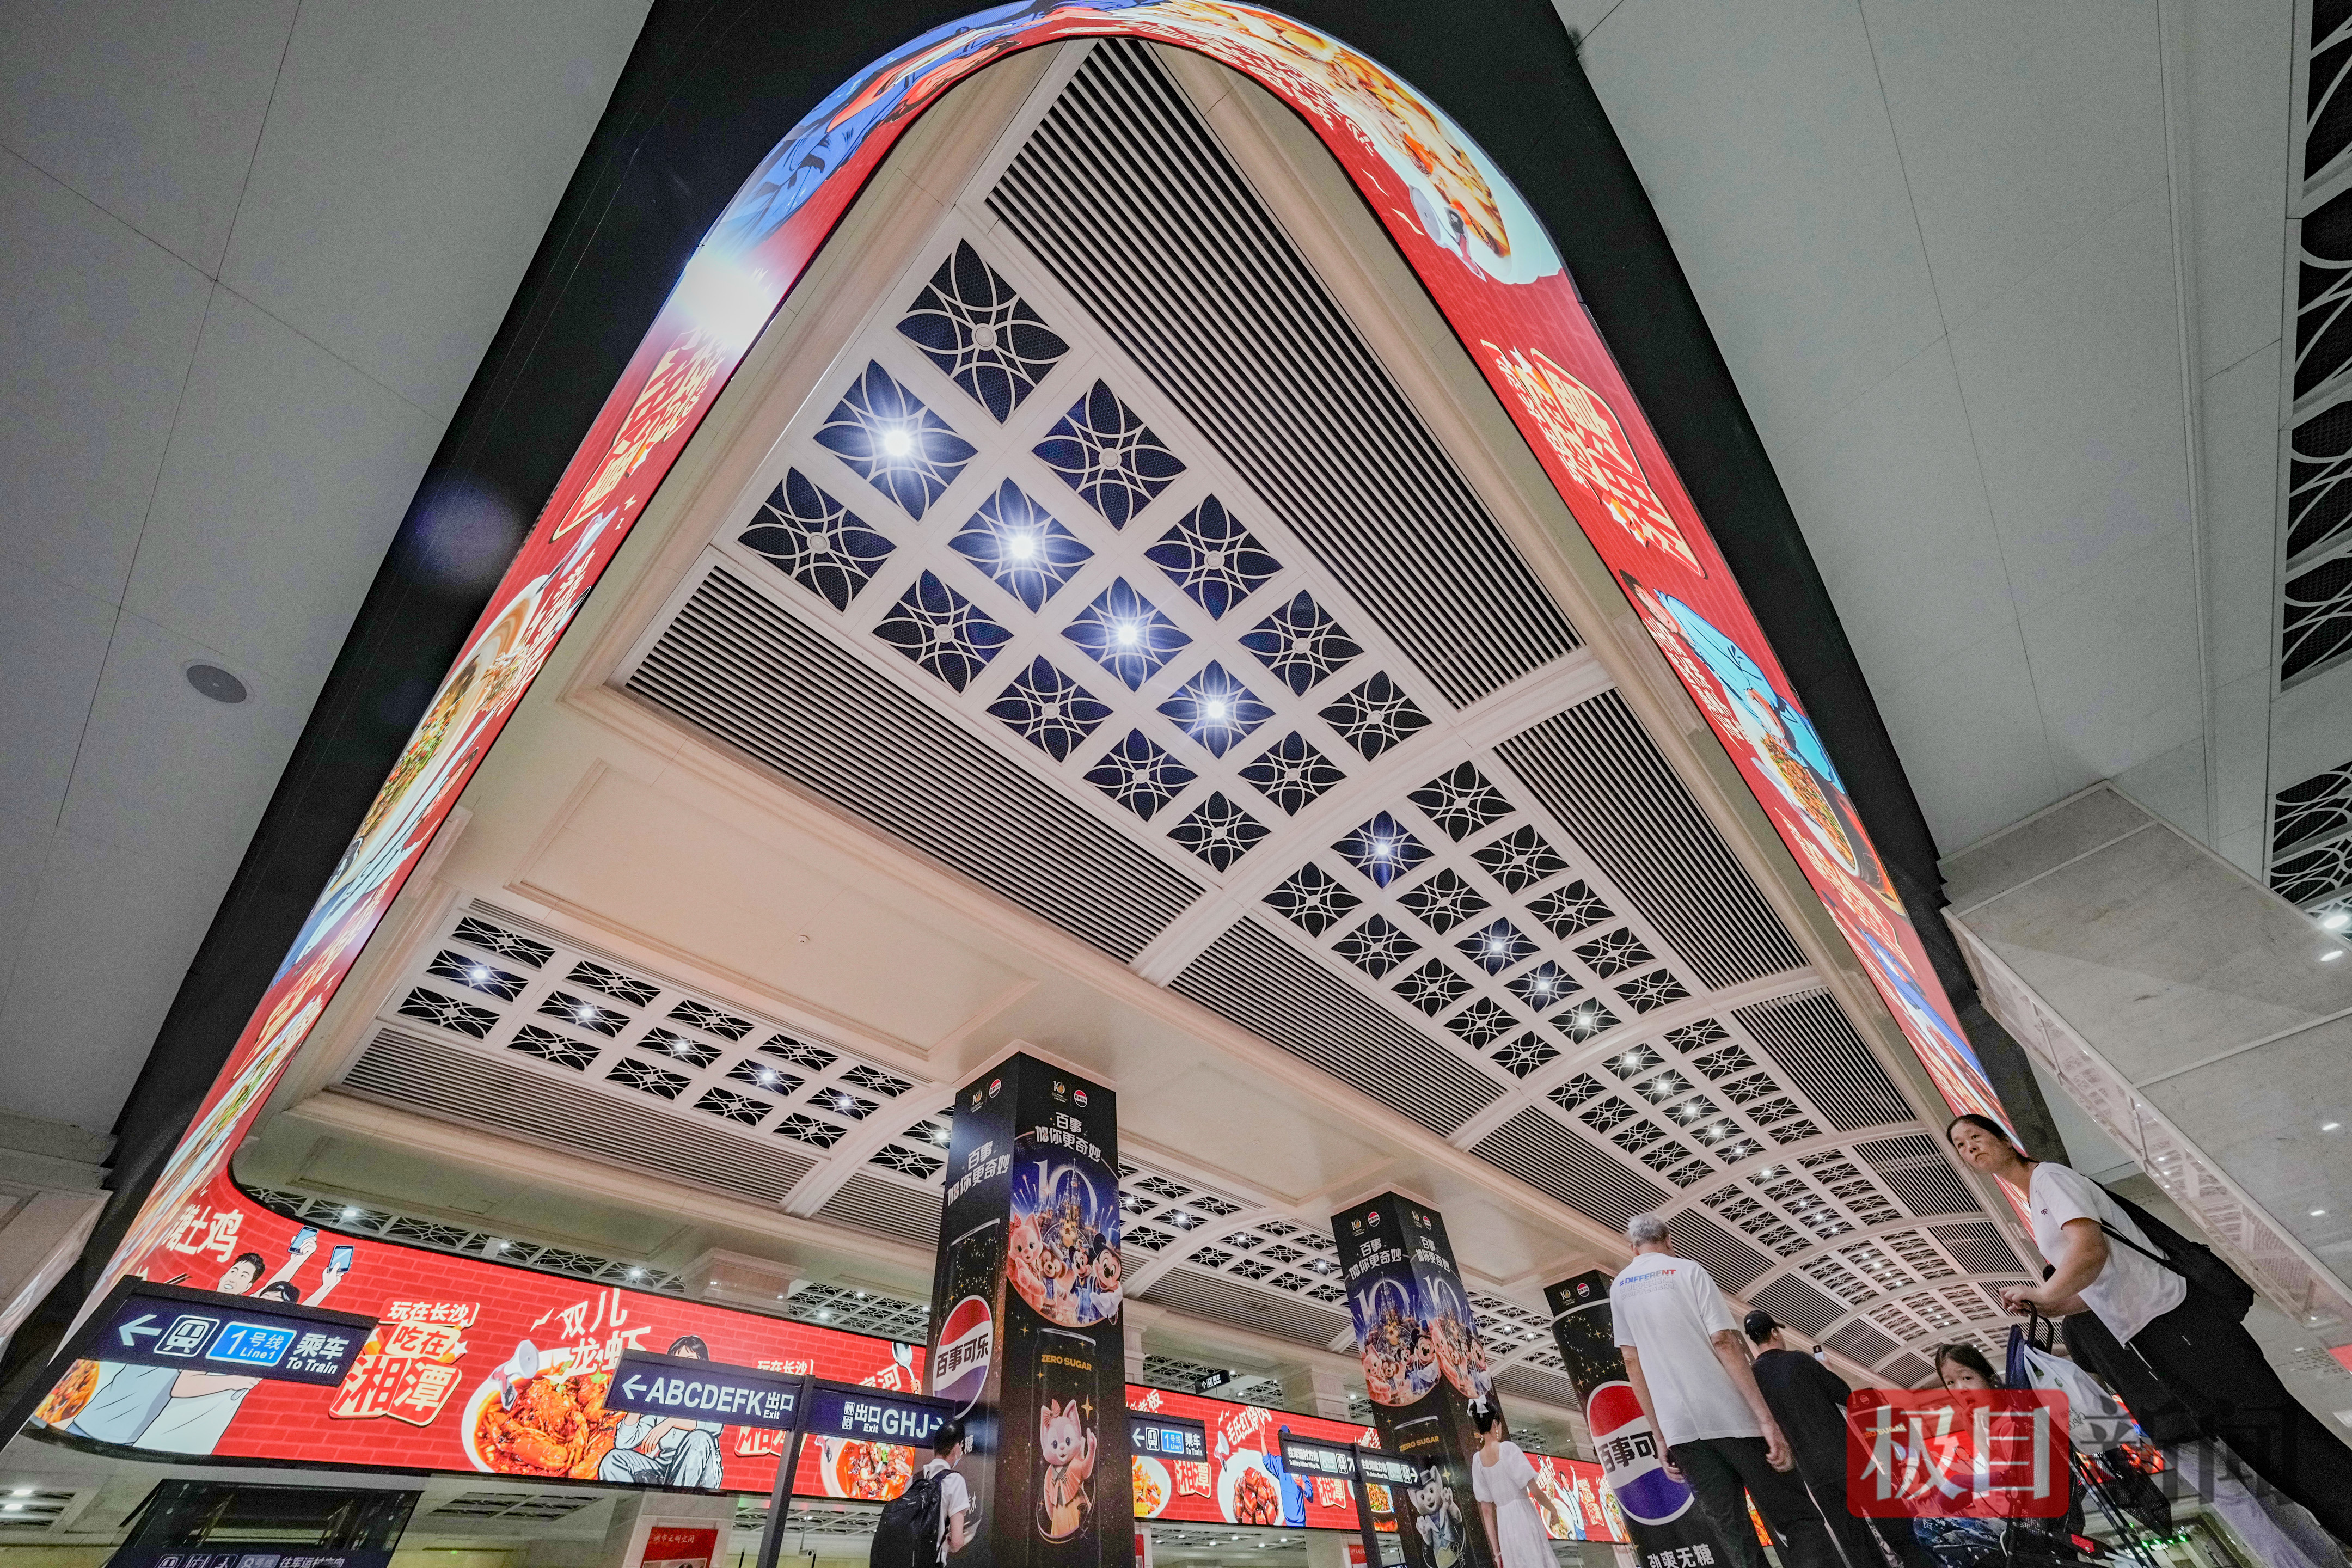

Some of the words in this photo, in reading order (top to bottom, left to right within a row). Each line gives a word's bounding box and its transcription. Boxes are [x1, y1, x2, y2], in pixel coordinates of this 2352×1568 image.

[1492, 357, 1589, 488] 玩在长沙
[1527, 383, 1598, 480] 吃在
[1535, 361, 1701, 575] 湘潭
[1056, 1111, 1082, 1133] 百事
[968, 1141, 994, 1171] 百事
[1034, 1125, 1102, 1163] 加你更奇妙
[947, 1153, 1010, 1206] 加你更奇妙
[1360, 1238, 1382, 1257] 百事
[1420, 1236, 1436, 1252] 百事
[1348, 1248, 1402, 1281] 加你更奇妙
[1619, 1269, 1676, 1287] #DIFFERENT
[387, 1300, 469, 1322] 玩在长沙
[227, 1329, 285, 1355] 1号线
[293, 1332, 350, 1361] 乘车
[393, 1326, 451, 1357] 吃在
[286, 1356, 303, 1370] To
[304, 1359, 338, 1375] Train
[757, 1359, 808, 1376] 玩在长沙
[936, 1332, 989, 1379] 百事可乐
[1040, 1354, 1063, 1367] ZERO
[1064, 1357, 1092, 1372] SUGAR
[334, 1355, 457, 1413] 湘潭
[645, 1377, 766, 1417] ABCDEFK
[765, 1391, 794, 1412] 出口
[763, 1409, 780, 1420] Exit
[854, 1404, 881, 1424] 出口
[881, 1408, 929, 1439] GHJ
[1226, 1406, 1273, 1446] 毛氏红烧肉
[863, 1423, 879, 1434] Exit
[1184, 1432, 1202, 1448] 乘车
[1186, 1447, 1191, 1455] To
[1191, 1448, 1203, 1457] Train
[1399, 1441, 1416, 1452] ZERO
[1416, 1436, 1439, 1447] SUGAR
[1647, 1543, 1715, 1568] 劲爽无糖
